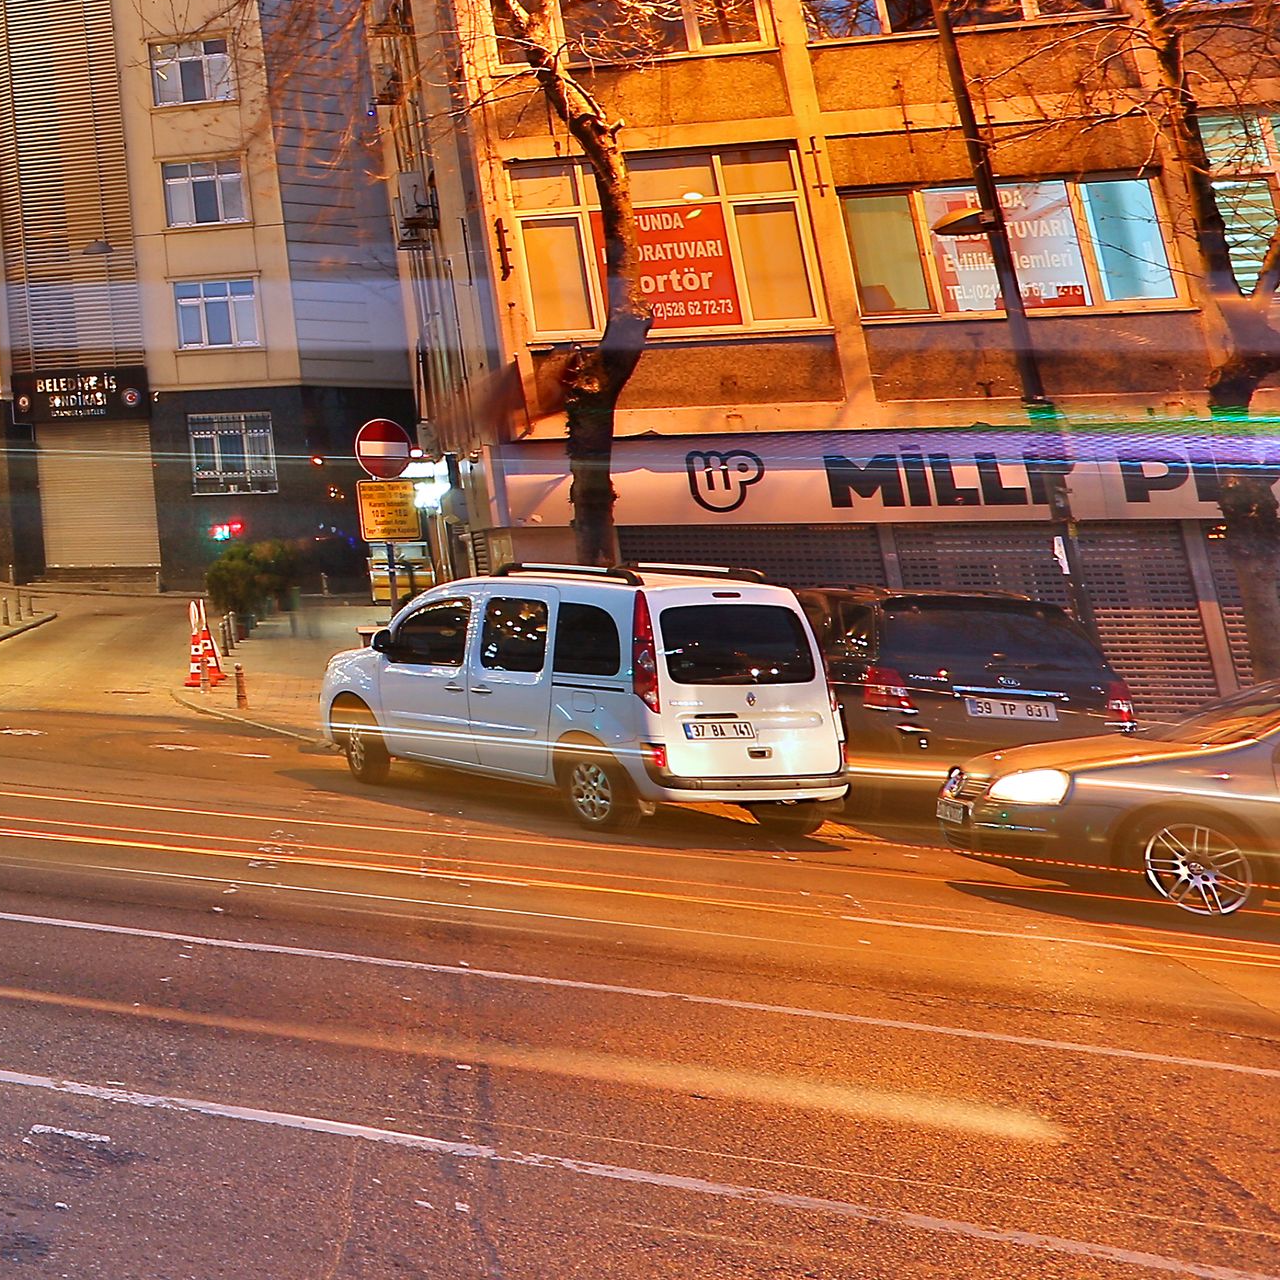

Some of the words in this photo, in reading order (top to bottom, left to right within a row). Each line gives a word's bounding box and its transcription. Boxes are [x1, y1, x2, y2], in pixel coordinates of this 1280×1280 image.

[965, 190, 1026, 209] FDA
[1013, 249, 1074, 270] lemleri
[640, 267, 713, 294] ortör
[687, 302, 702, 316] 62
[703, 299, 734, 315] 72-73
[36, 372, 117, 393] BELEDİYE-İŞ
[976, 701, 992, 714] 59
[1000, 703, 1016, 715] TP
[1025, 704, 1050, 718] 831
[692, 725, 705, 737] 37
[711, 725, 726, 737] BA
[733, 724, 751, 737] 141
